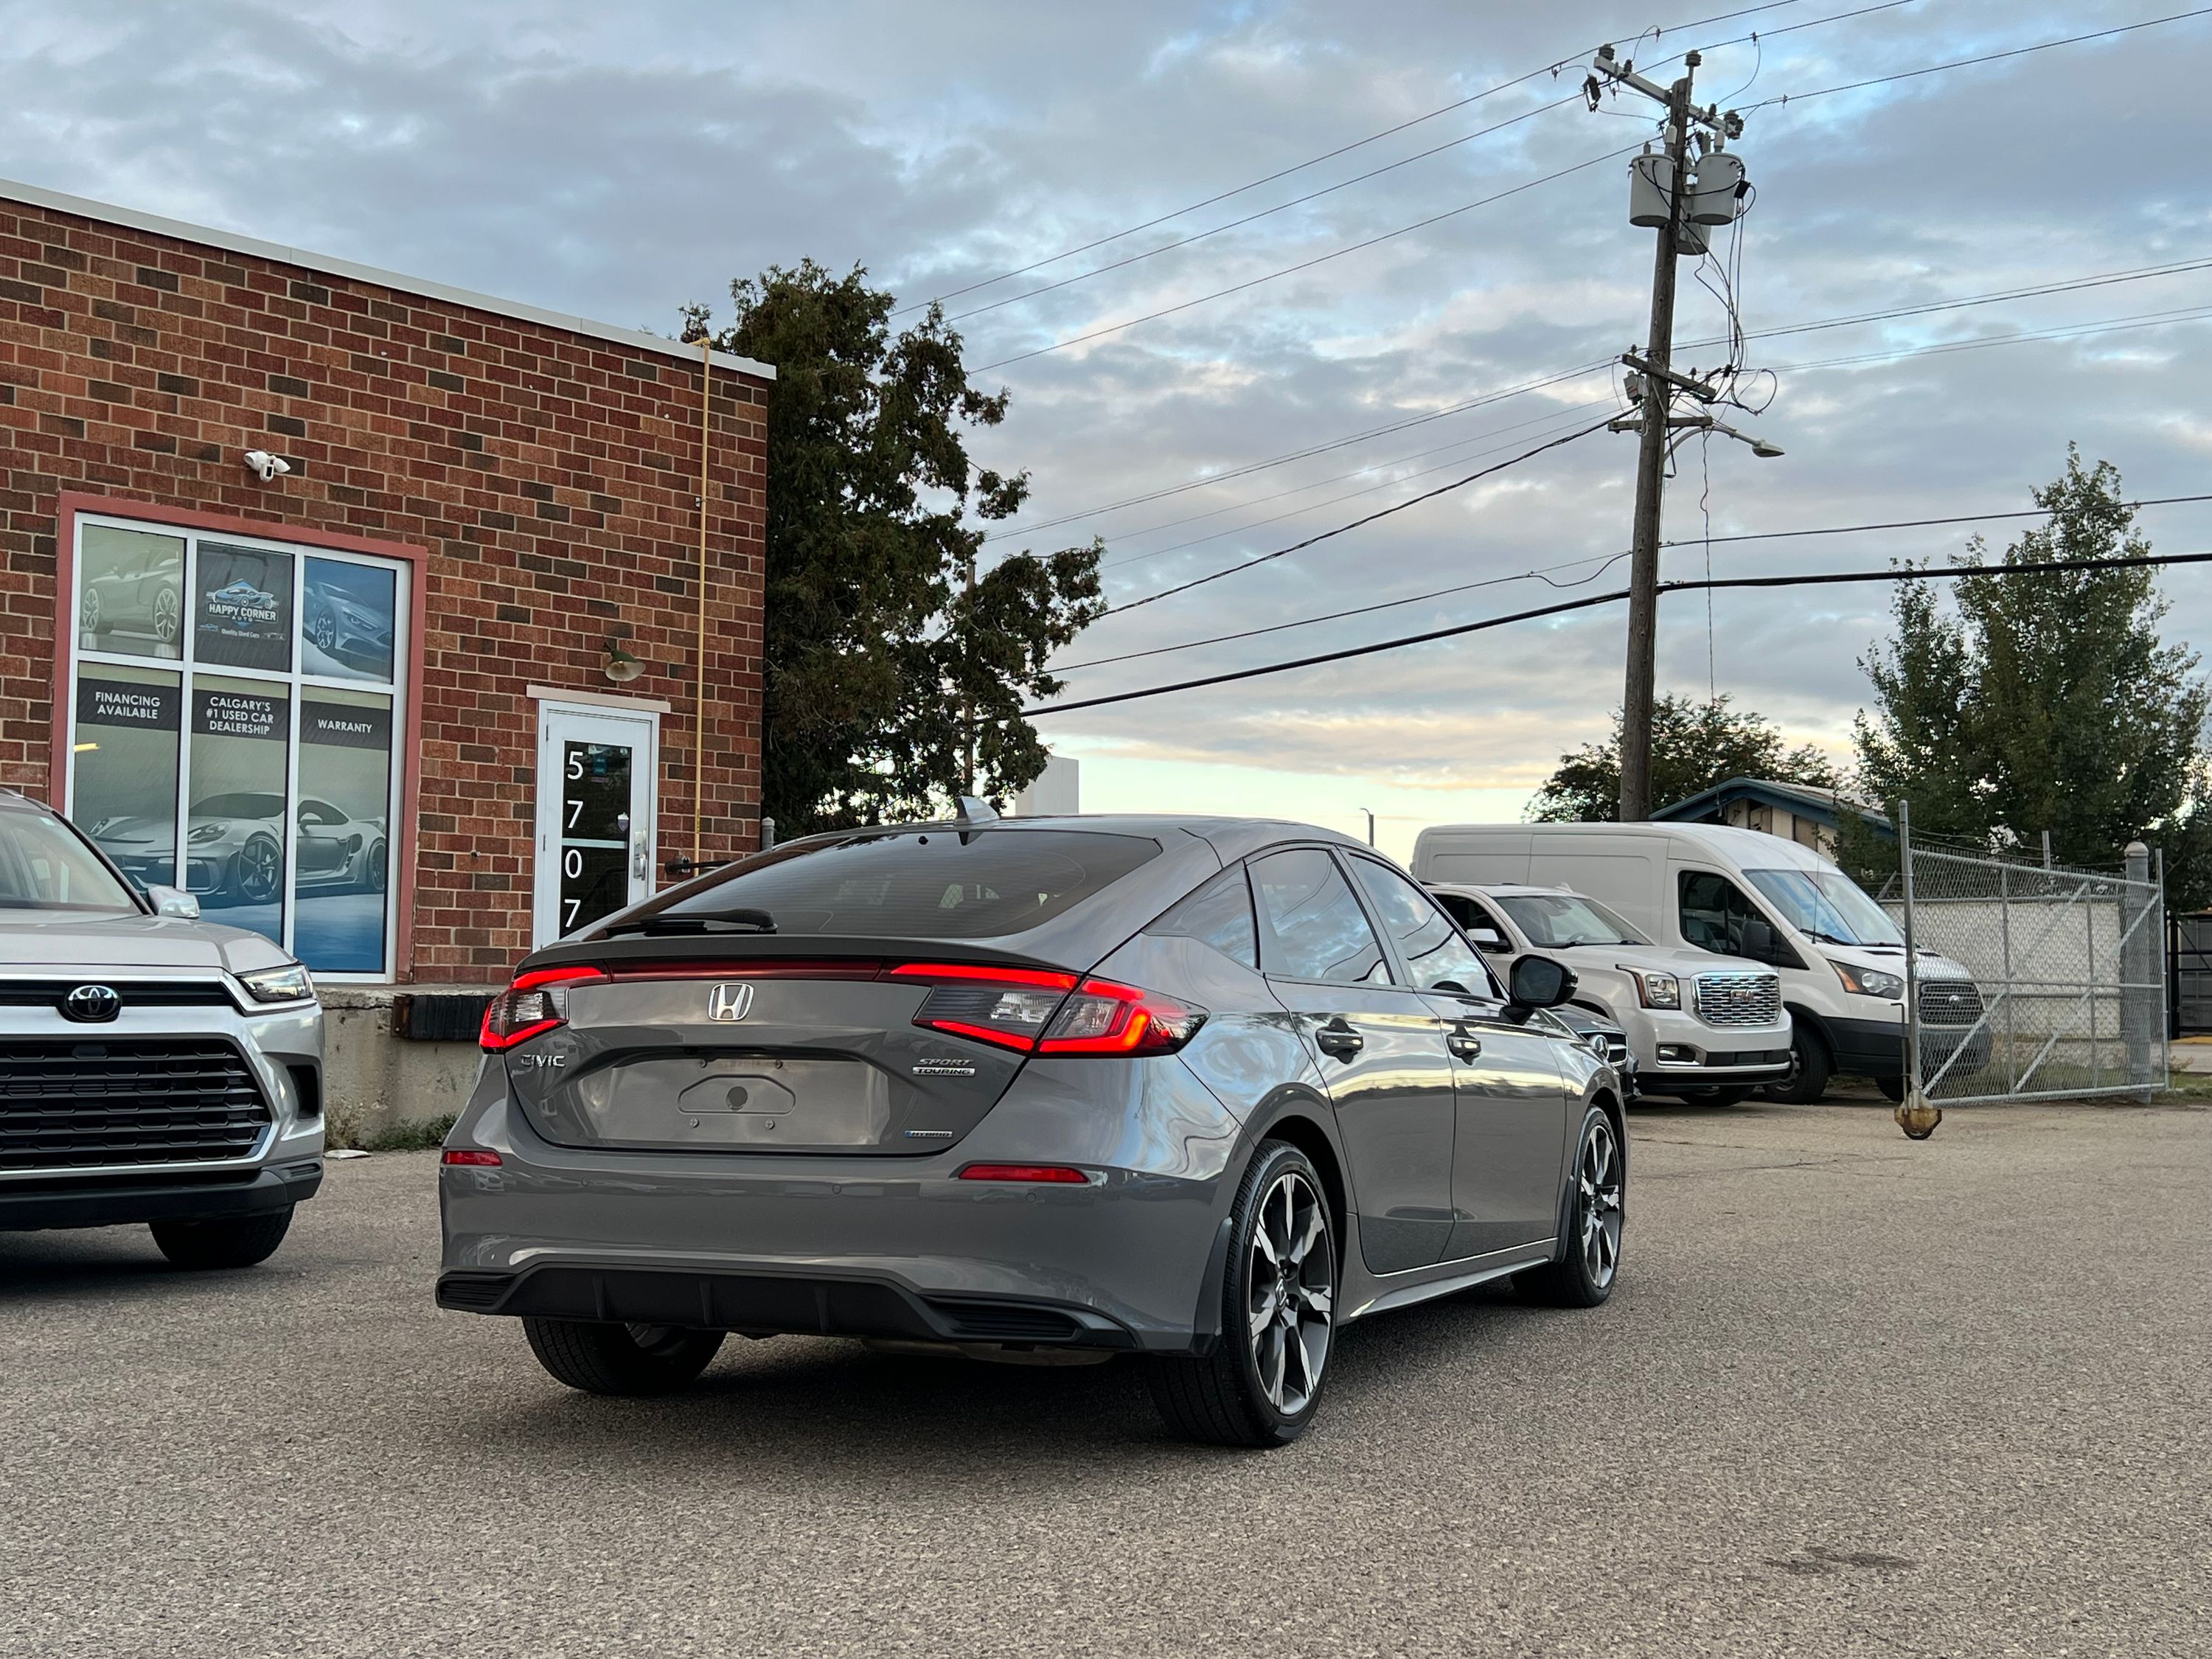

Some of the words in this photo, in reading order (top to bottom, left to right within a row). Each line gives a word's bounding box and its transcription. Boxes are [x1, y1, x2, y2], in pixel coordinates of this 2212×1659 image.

[209, 604, 239, 616] HAPPY
[240, 608, 276, 621] CORNER
[95, 692, 161, 707] FINANCING
[209, 696, 271, 712] CALGARY'S
[97, 704, 158, 719] AVAILABLE
[206, 708, 218, 719] #1
[222, 709, 248, 721] USED
[251, 712, 274, 724] CAR
[209, 720, 271, 735] DEALERSHIP
[318, 719, 372, 733] WARRANTY
[521, 1054, 566, 1067] CIVIC
[917, 1058, 974, 1066] SPORT
